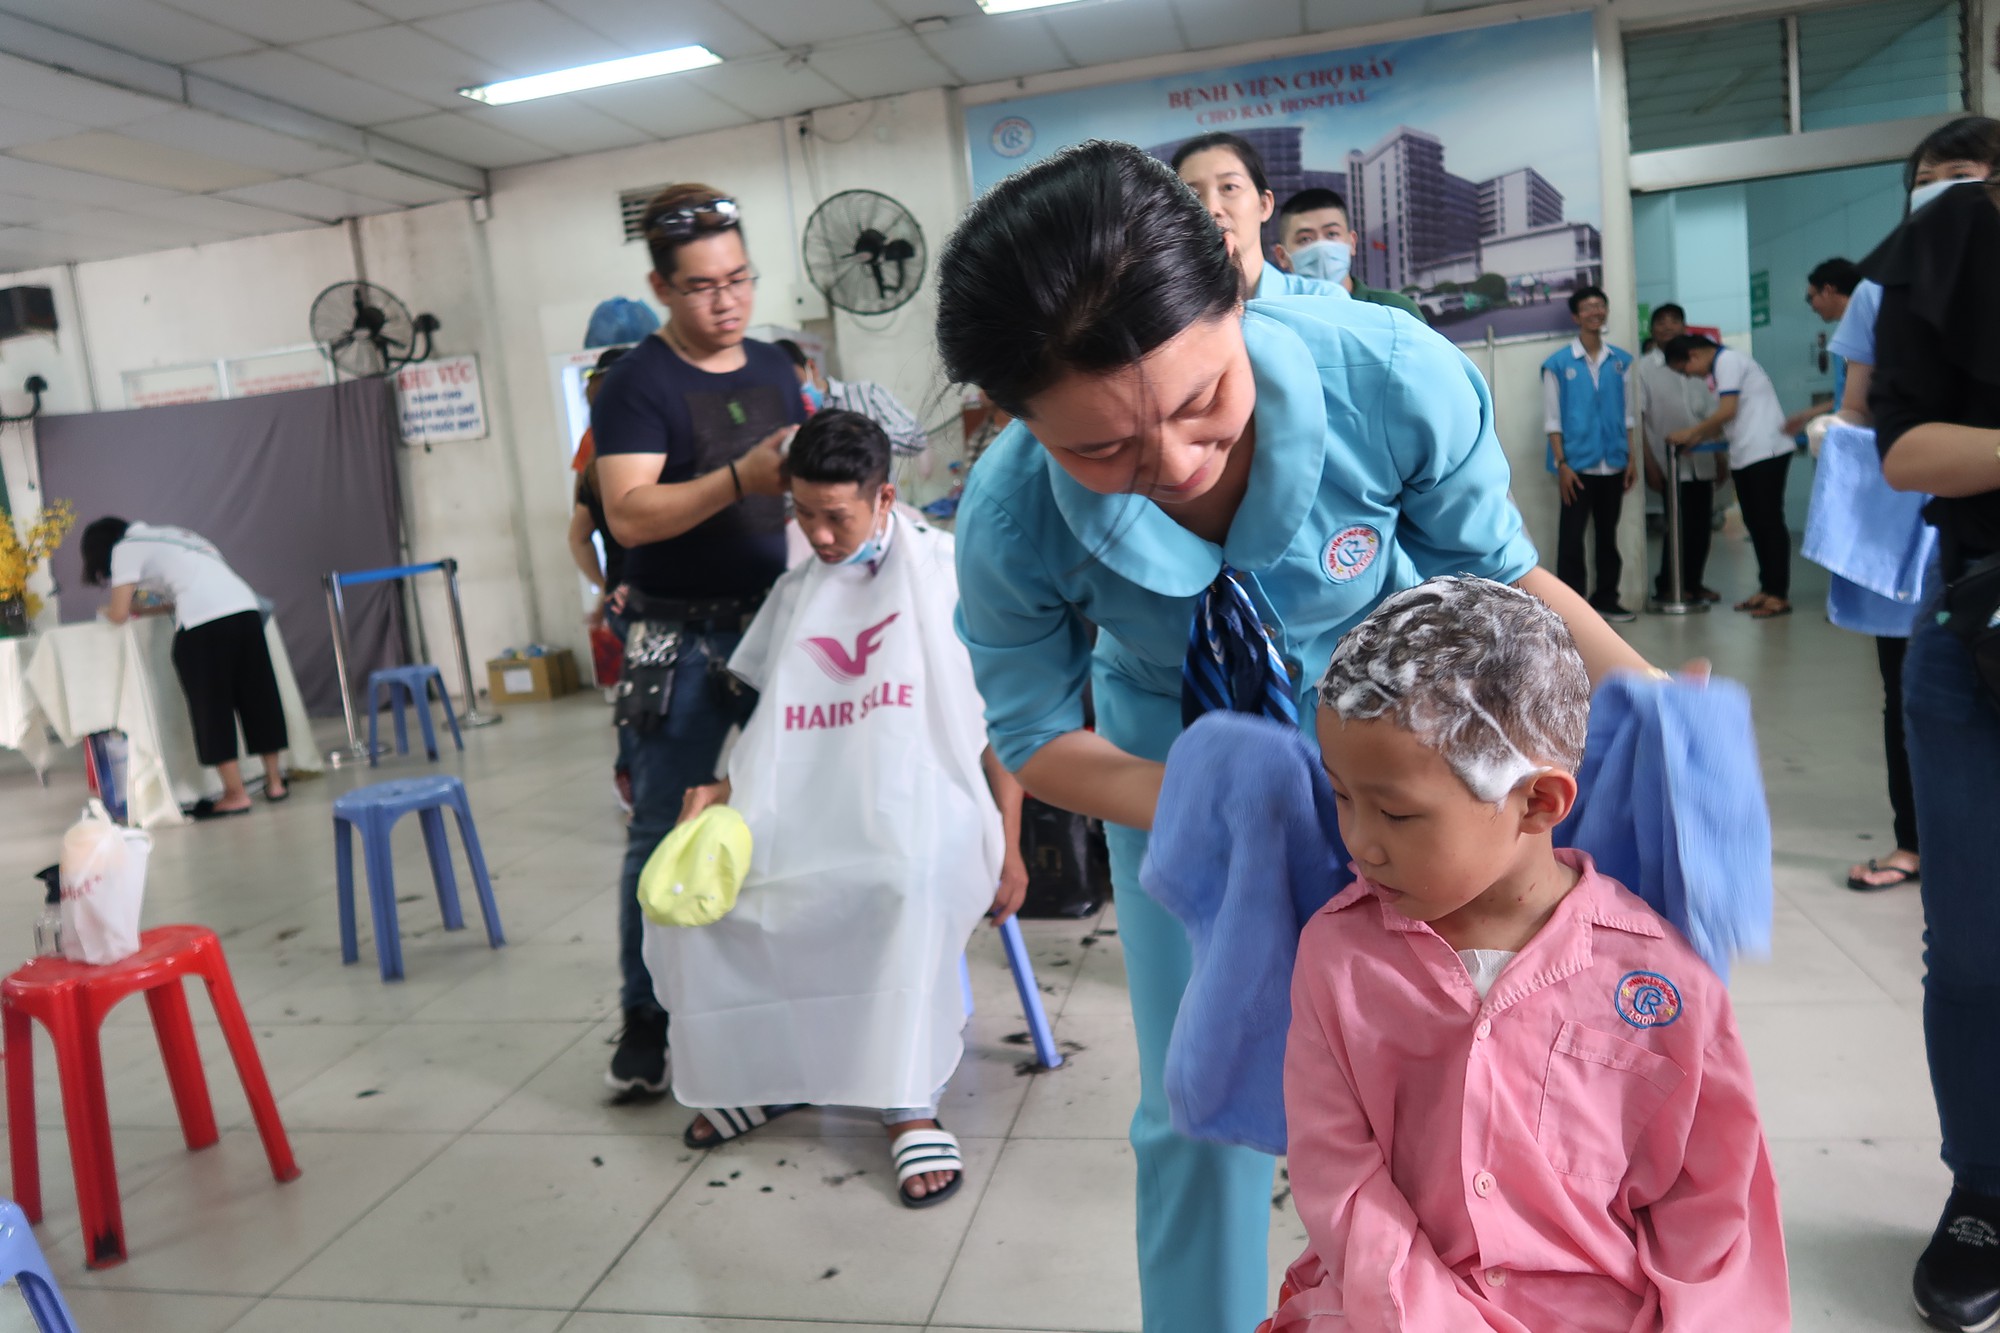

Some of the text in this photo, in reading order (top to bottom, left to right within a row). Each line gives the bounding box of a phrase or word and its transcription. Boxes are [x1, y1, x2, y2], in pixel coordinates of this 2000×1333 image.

[1167, 82, 1229, 110] BỆNH
[1232, 74, 1288, 98] VIỆN
[1292, 66, 1345, 90] CHỢ
[1196, 88, 1369, 125] CHO RAY HOSPITAL
[785, 701, 854, 731] HAIR
